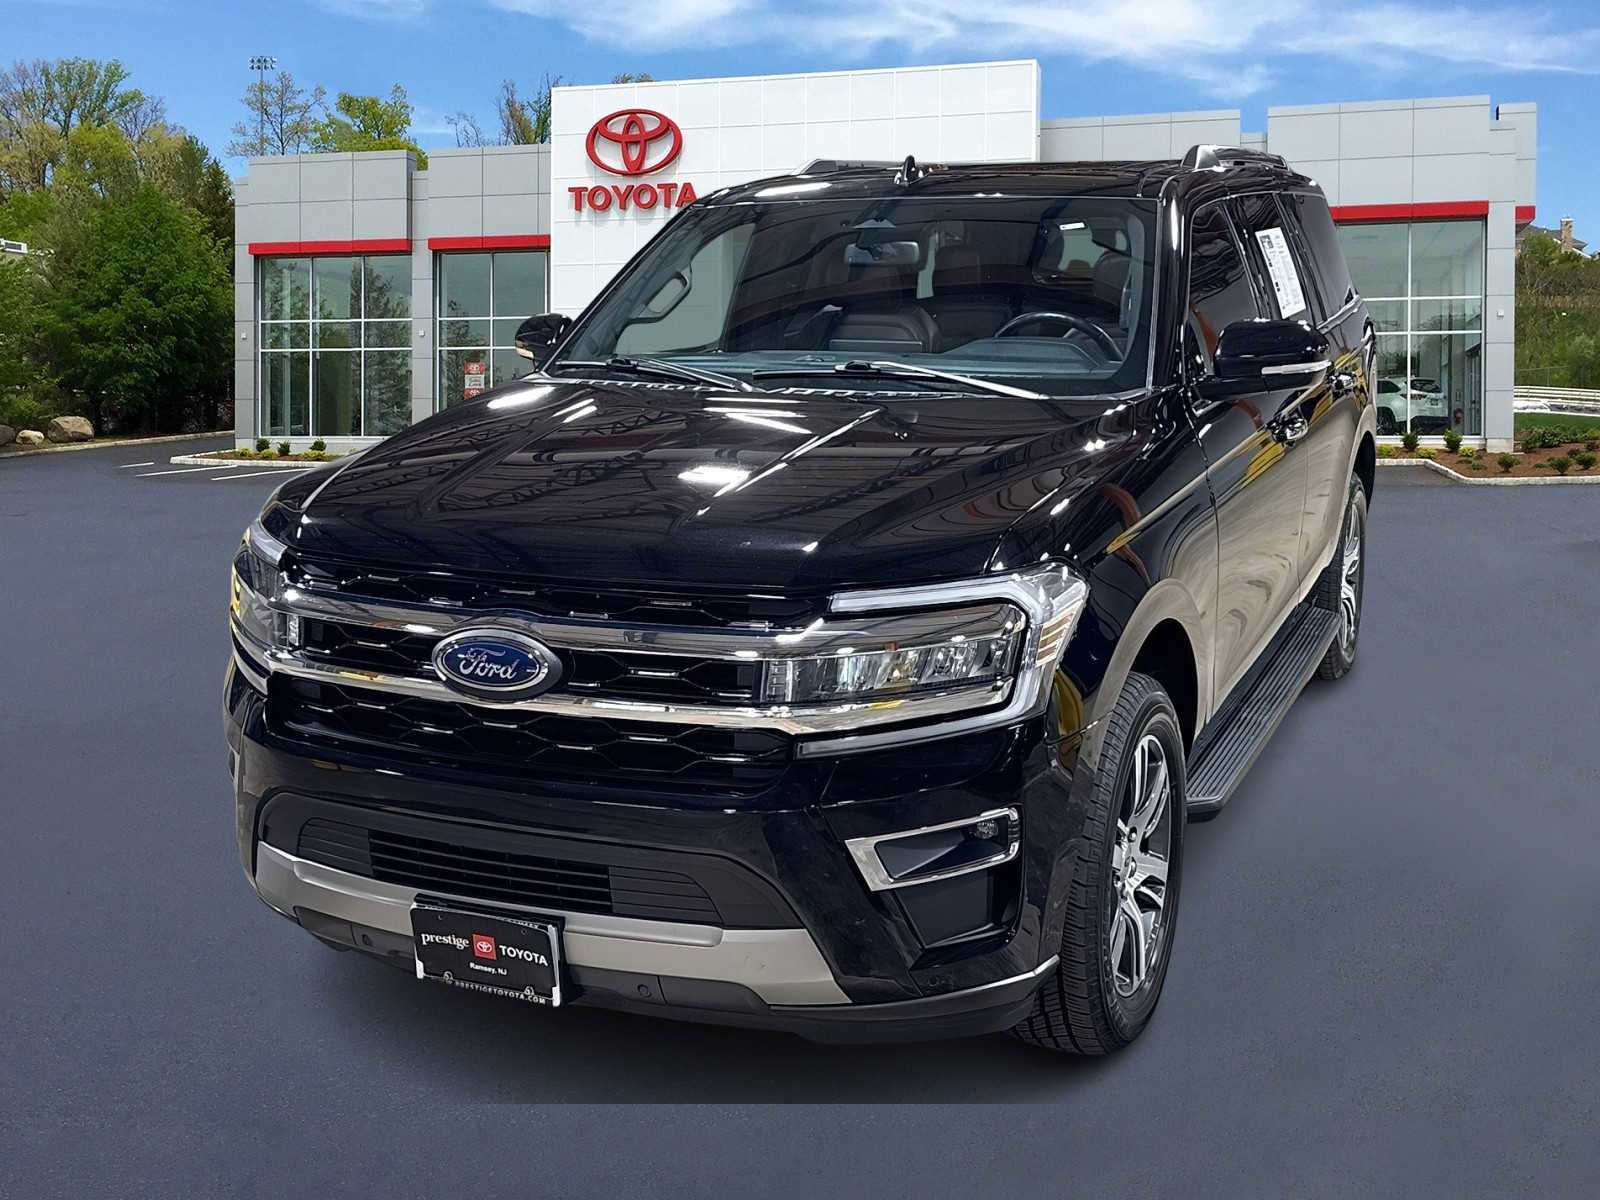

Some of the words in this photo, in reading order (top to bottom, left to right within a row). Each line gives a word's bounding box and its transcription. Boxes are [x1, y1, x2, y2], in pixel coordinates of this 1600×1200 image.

[568, 182, 697, 211] TOYOTA
[459, 647, 519, 679] Ford
[421, 933, 470, 949] prestige
[499, 945, 548, 966] TOYOTA
